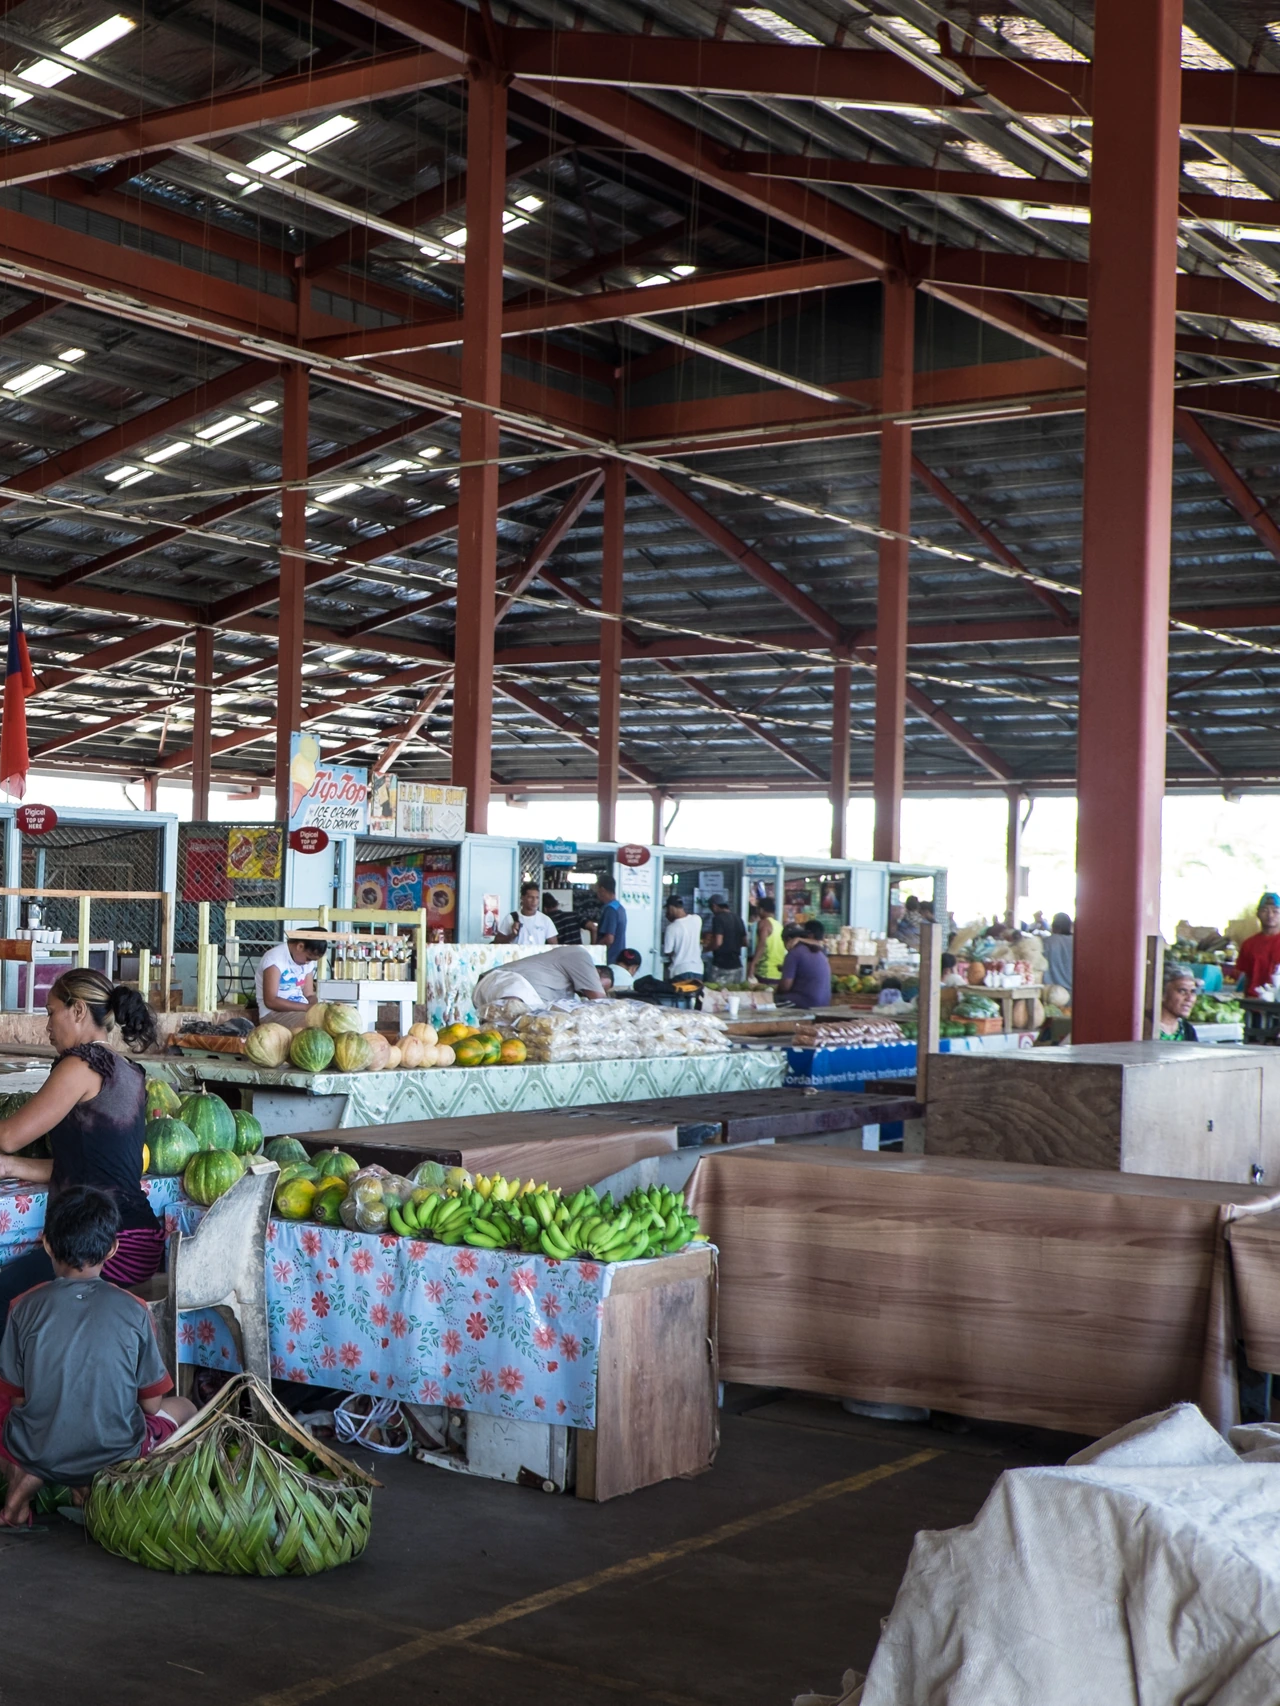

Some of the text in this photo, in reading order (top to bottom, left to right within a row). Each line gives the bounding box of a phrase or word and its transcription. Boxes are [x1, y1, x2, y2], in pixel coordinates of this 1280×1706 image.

[309, 772, 367, 805] Tip Top
[24, 808, 46, 817] Digicel
[314, 806, 359, 820] ICE CREAM
[312, 817, 332, 830] COLD
[332, 819, 360, 831] DRINKS
[299, 831, 319, 840] Digicel
[545, 844, 573, 853] bluesky
